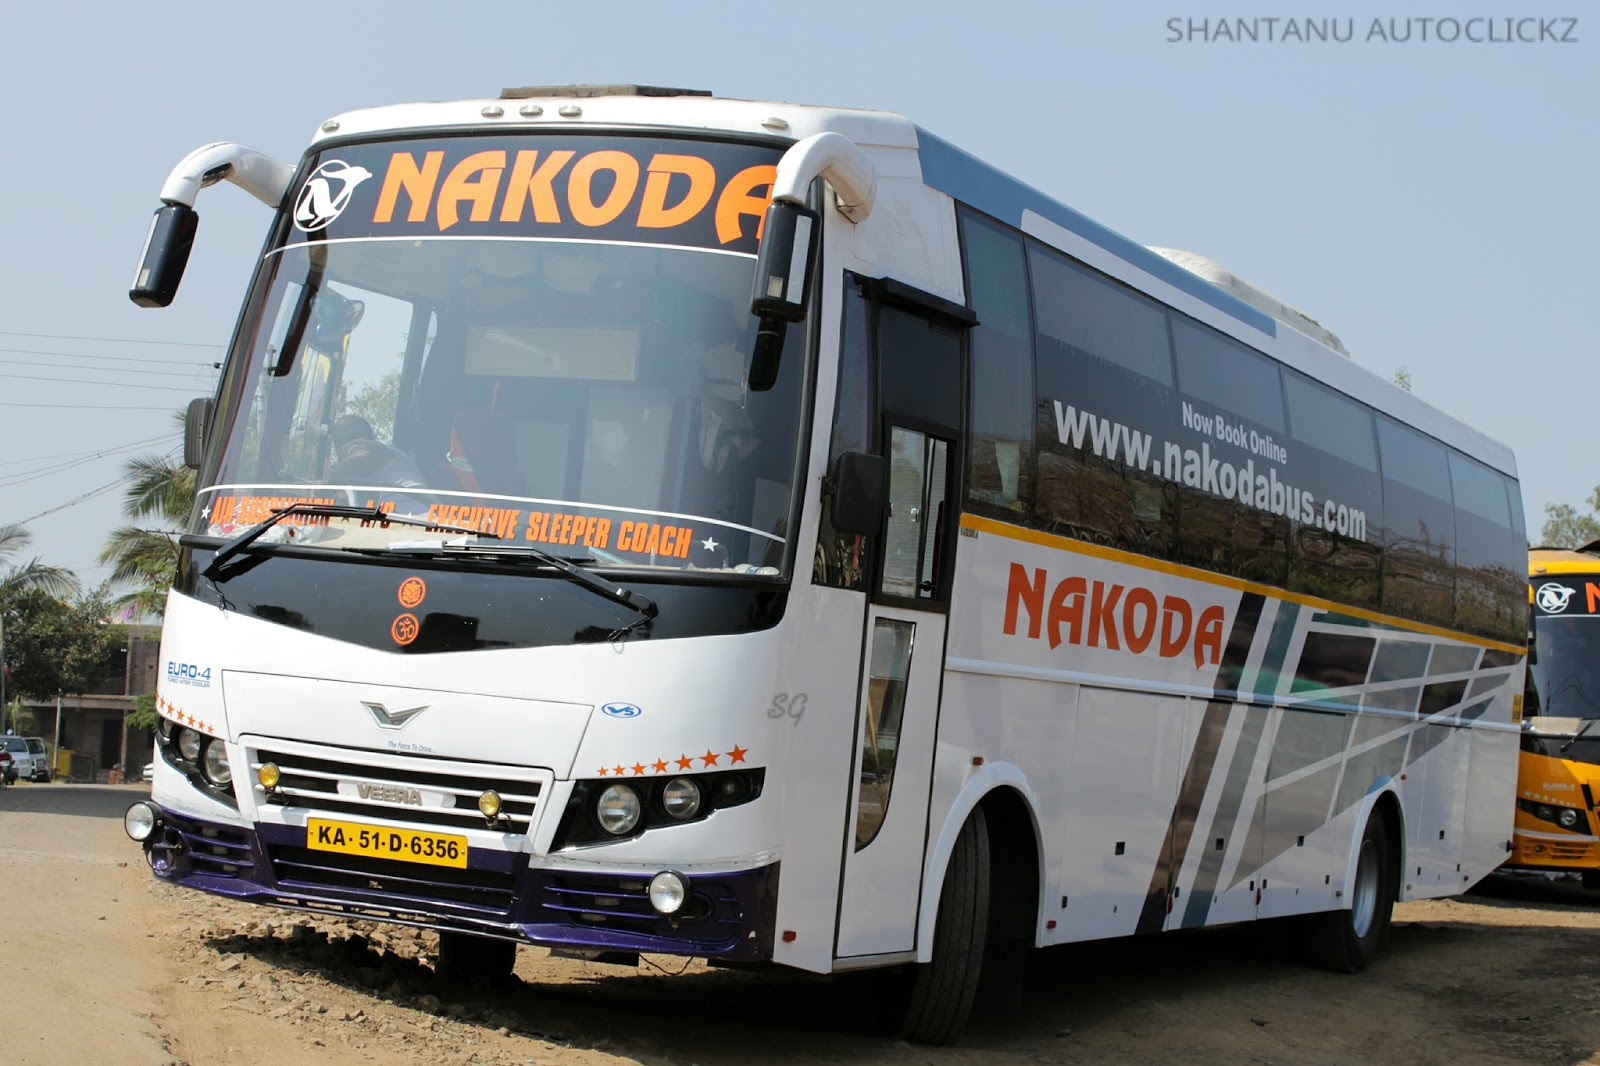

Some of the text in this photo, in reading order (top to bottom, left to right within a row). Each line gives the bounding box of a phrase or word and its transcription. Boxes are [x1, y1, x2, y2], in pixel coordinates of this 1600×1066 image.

[372, 149, 778, 245] NAKODA
[1182, 400, 1287, 465] Now Book Online
[1053, 400, 1367, 542] www.nakodabus.com
[210, 496, 238, 524] AIR
[424, 503, 521, 540] EXECUTIVE
[525, 511, 612, 549] SLEEPER
[616, 520, 693, 559] COACH
[1002, 562, 1226, 671] NAKODA
[388, 741, 397, 749] The
[398, 742, 411, 751] Force
[357, 783, 424, 807] VEERA
